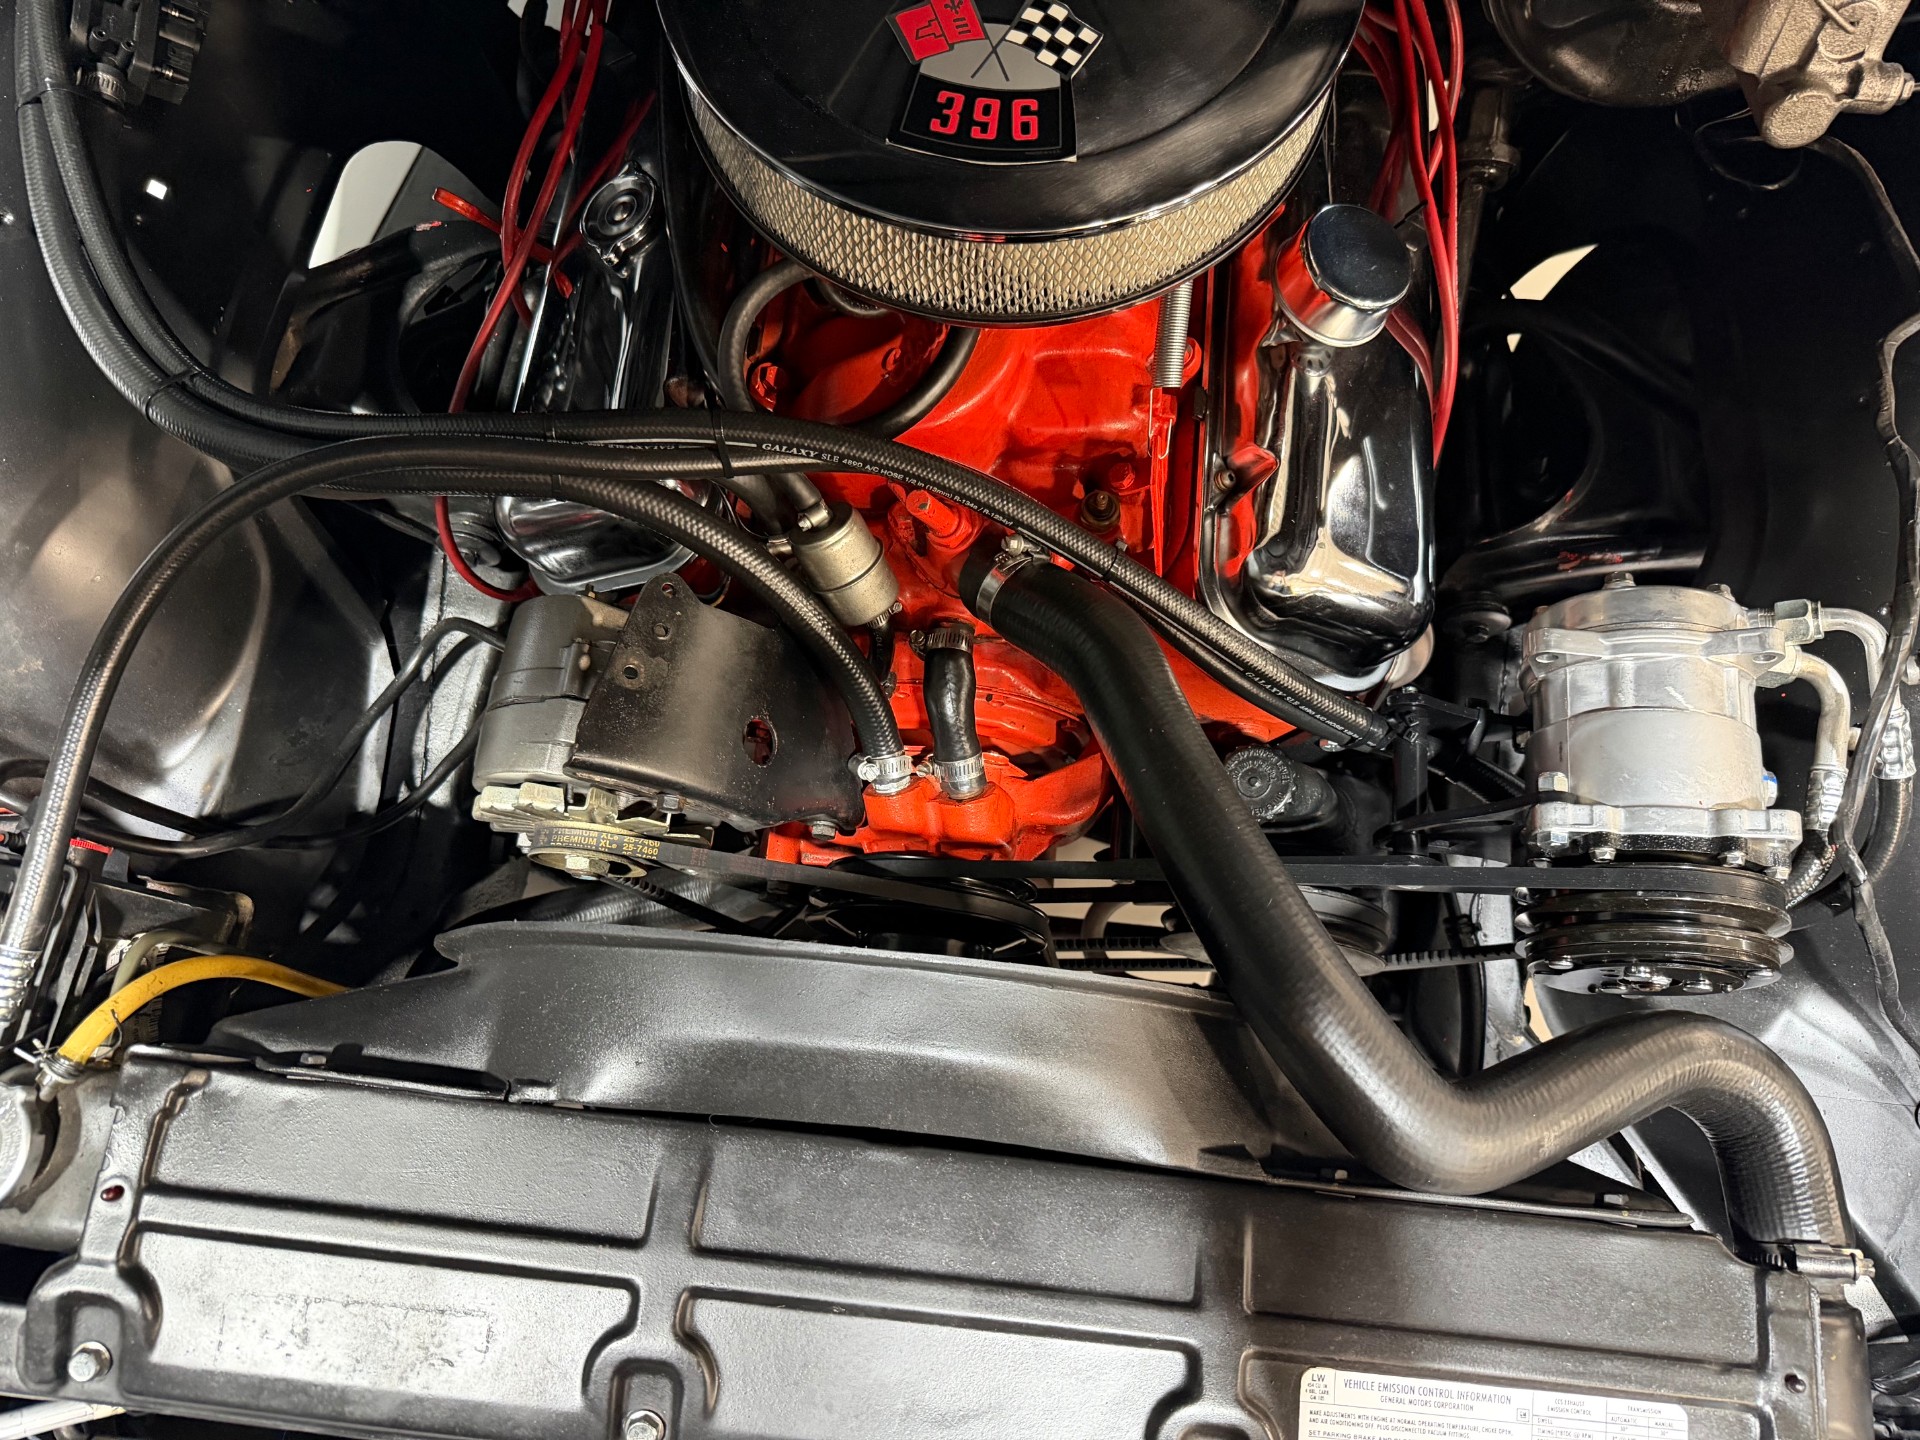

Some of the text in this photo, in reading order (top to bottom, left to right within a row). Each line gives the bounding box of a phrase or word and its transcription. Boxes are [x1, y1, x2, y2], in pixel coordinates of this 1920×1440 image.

[929, 90, 1039, 141] 396
[762, 443, 819, 458] GALAXY
[821, 453, 840, 463] SLE
[864, 464, 880, 473] A/C
[880, 469, 904, 480] HOSE
[905, 476, 917, 486] 1/2
[552, 827, 599, 838] PREMIUM
[551, 834, 597, 846] PREMIUM
[622, 843, 659, 856] 25-7460
[1311, 1373, 1326, 1383] LW
[1343, 1378, 1512, 1405] VEHICLE EMISSION CONTROL INFORMATION
[1379, 1395, 1474, 1411] GENERAL MOTORS CORPORATION
[1627, 1405, 1662, 1415] TRANSMISSION
[1309, 1409, 1322, 1417] MAKE
[1323, 1411, 1356, 1420] ADJUSTMENTS
[1370, 1415, 1388, 1423] ENGINE
[1396, 1418, 1417, 1426] NORMAL
[1418, 1420, 1445, 1429] OPERATING
[1481, 1426, 1498, 1434] CHOKE
[1329, 1419, 1364, 1428] CONDITIONING
[1376, 1423, 1390, 1431] PLUG
[1390, 1425, 1427, 1435] DISCONNECTED
[1427, 1429, 1447, 1437] VACUUM
[1610, 1416, 1638, 1425] AUTOMATIC
[1322, 1431, 1352, 1440] PARKING
